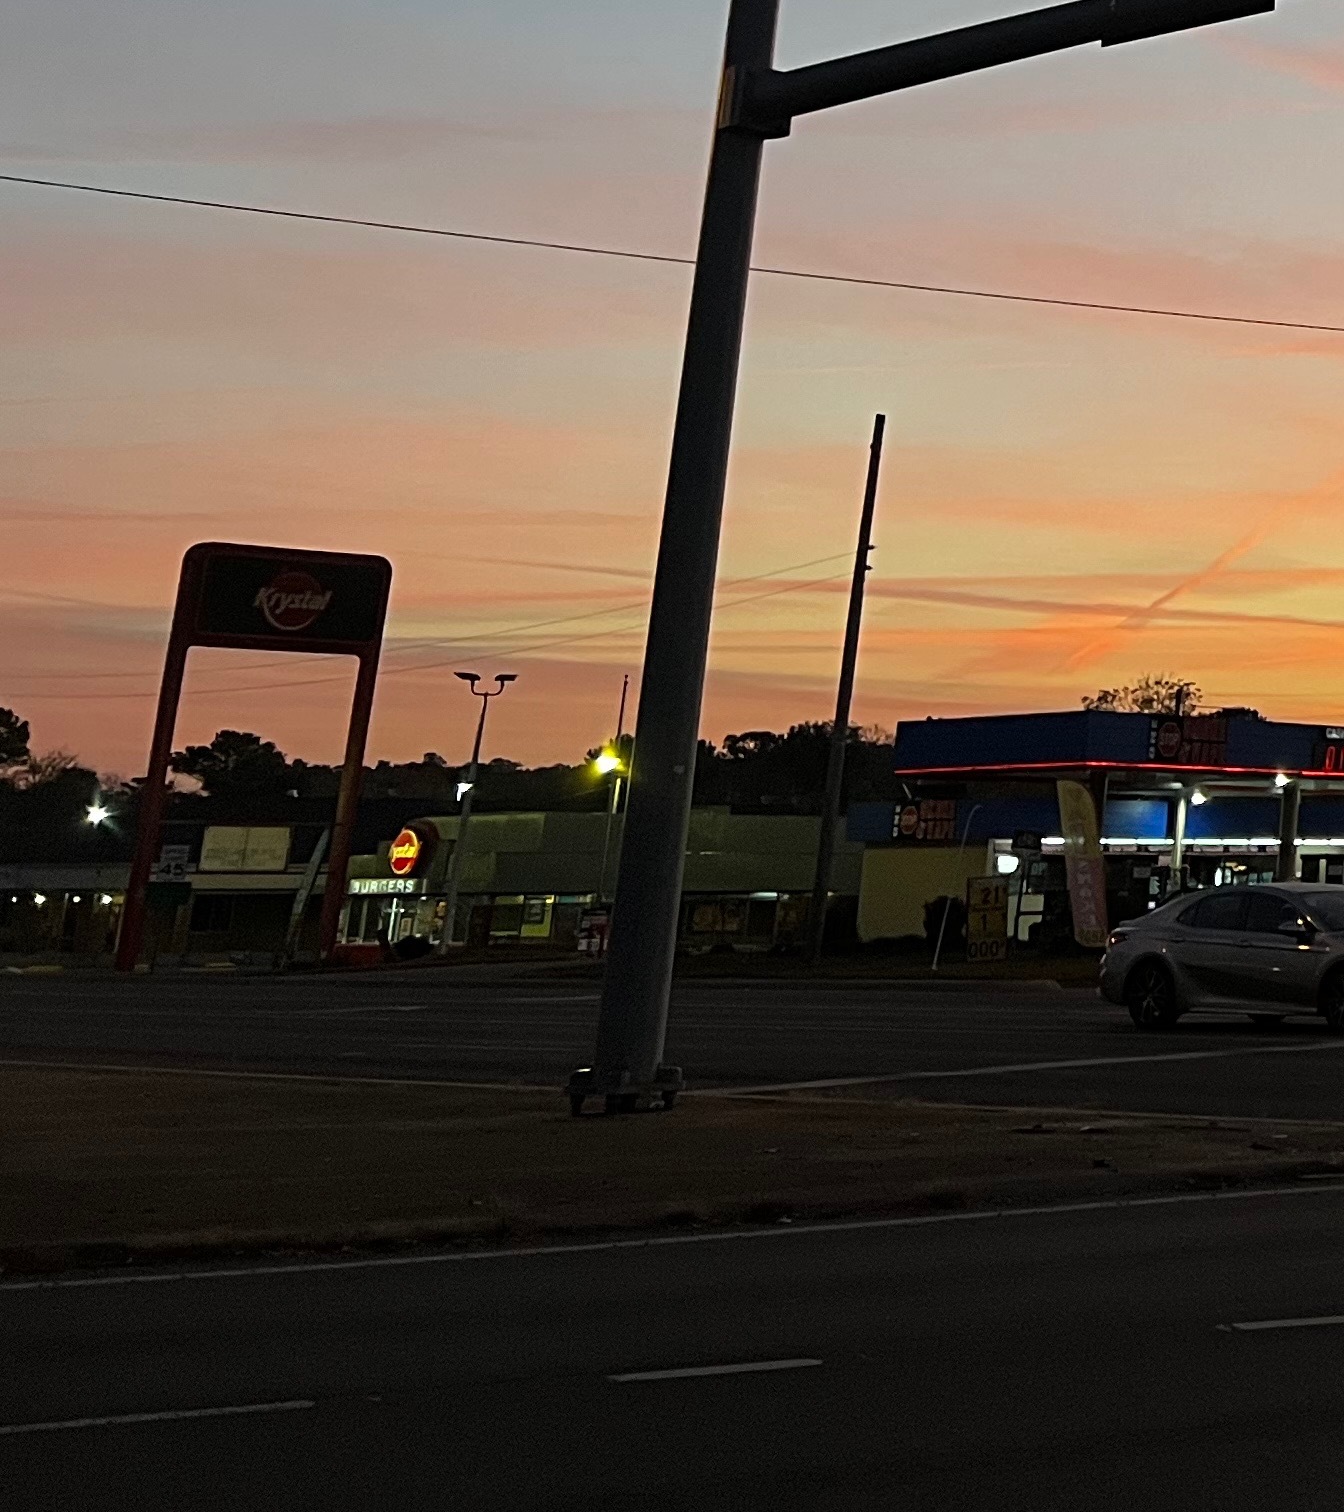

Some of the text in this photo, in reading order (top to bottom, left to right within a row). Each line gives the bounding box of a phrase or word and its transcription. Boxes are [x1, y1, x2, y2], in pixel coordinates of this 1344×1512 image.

[252, 587, 333, 616] Krystal
[160, 862, 184, 877] 45
[350, 878, 415, 894] BURGERS
